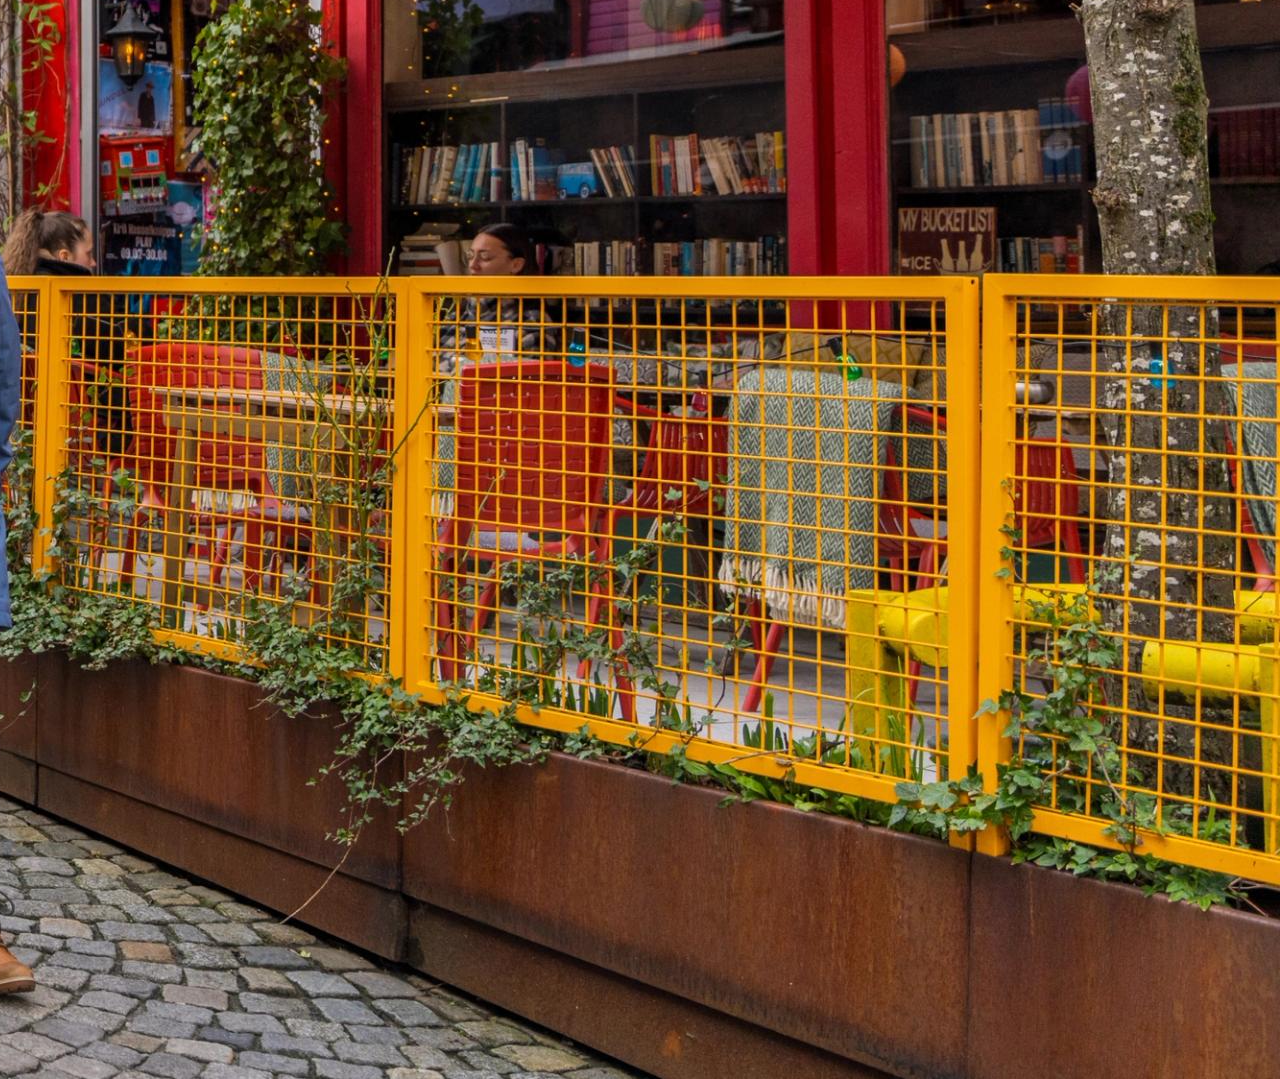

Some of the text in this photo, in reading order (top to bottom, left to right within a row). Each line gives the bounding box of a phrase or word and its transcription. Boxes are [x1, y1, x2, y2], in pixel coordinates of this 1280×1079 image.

[900, 209, 992, 232] MY BUCKET LIST
[911, 257, 931, 270] ICE
